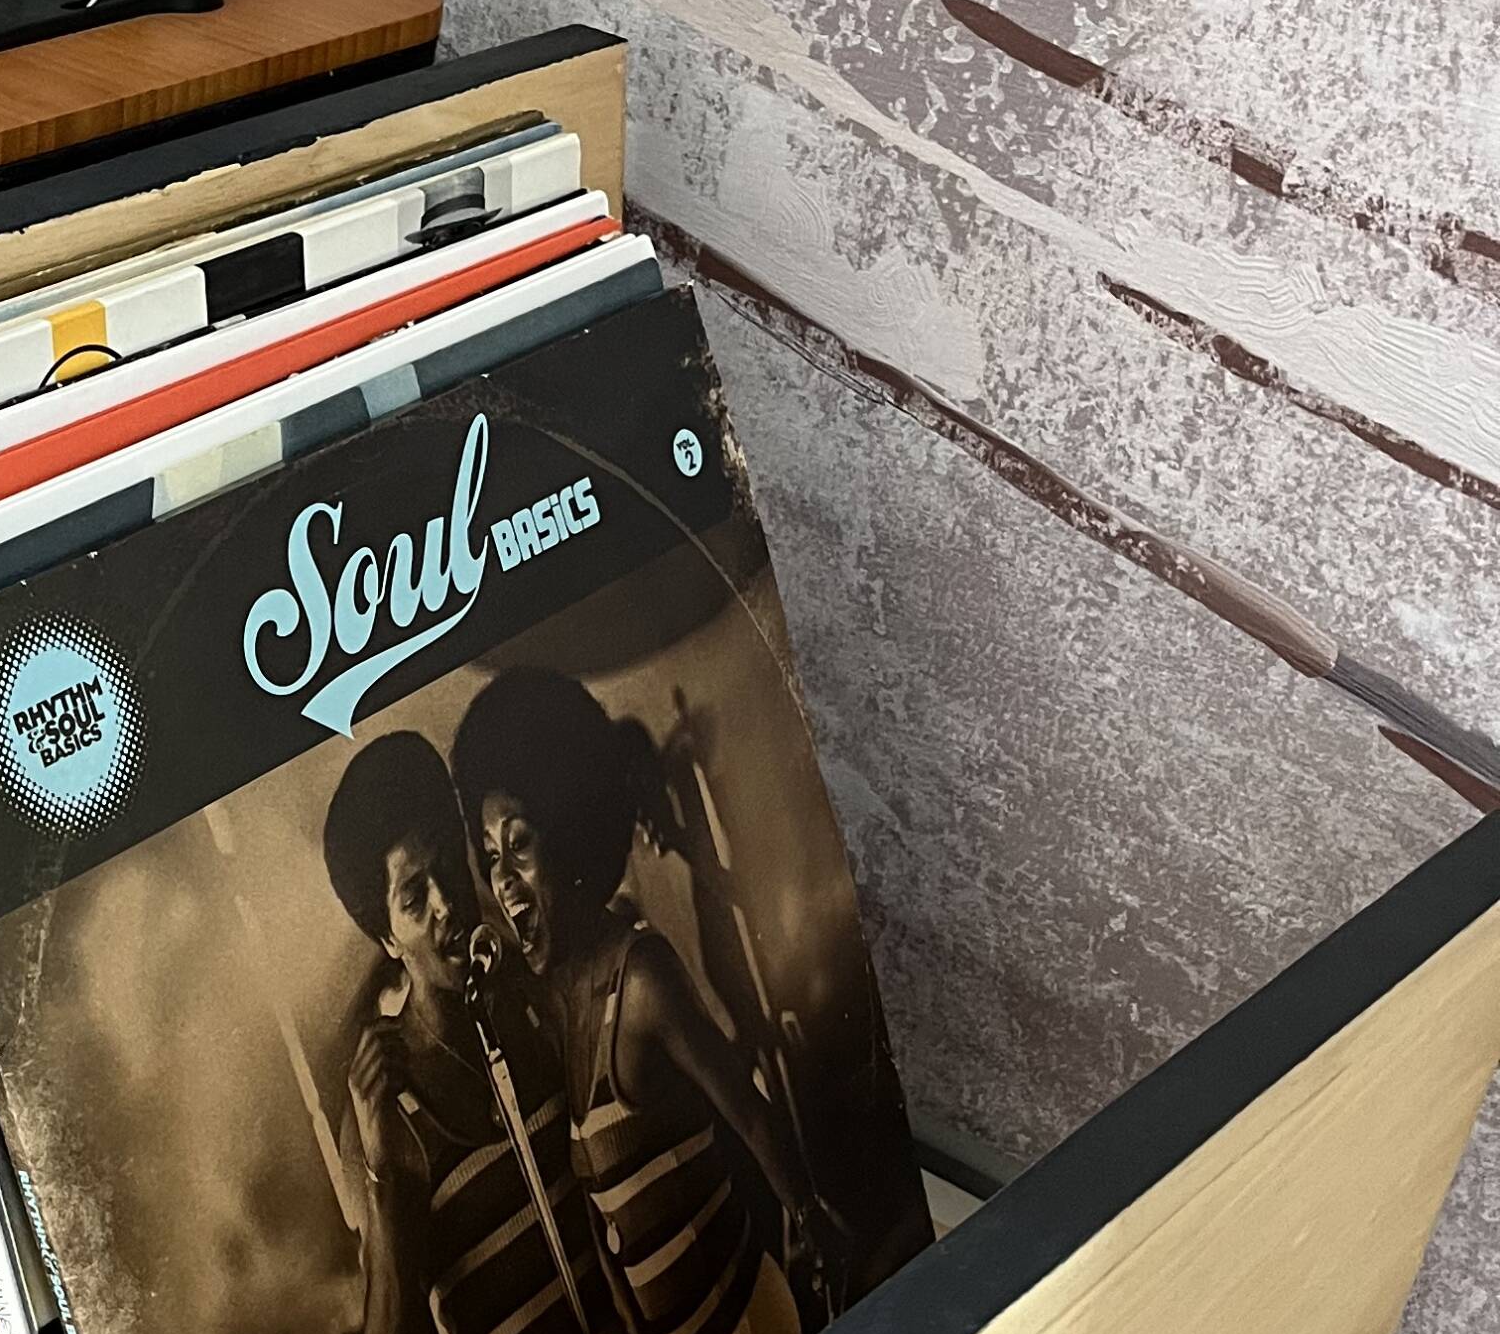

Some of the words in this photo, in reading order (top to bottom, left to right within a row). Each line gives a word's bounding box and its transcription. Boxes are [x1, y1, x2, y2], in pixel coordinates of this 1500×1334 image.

[684, 450, 697, 471] 2
[243, 413, 489, 738] Soul
[12, 674, 103, 736] RHYTHM
[39, 723, 103, 769] BASICS
